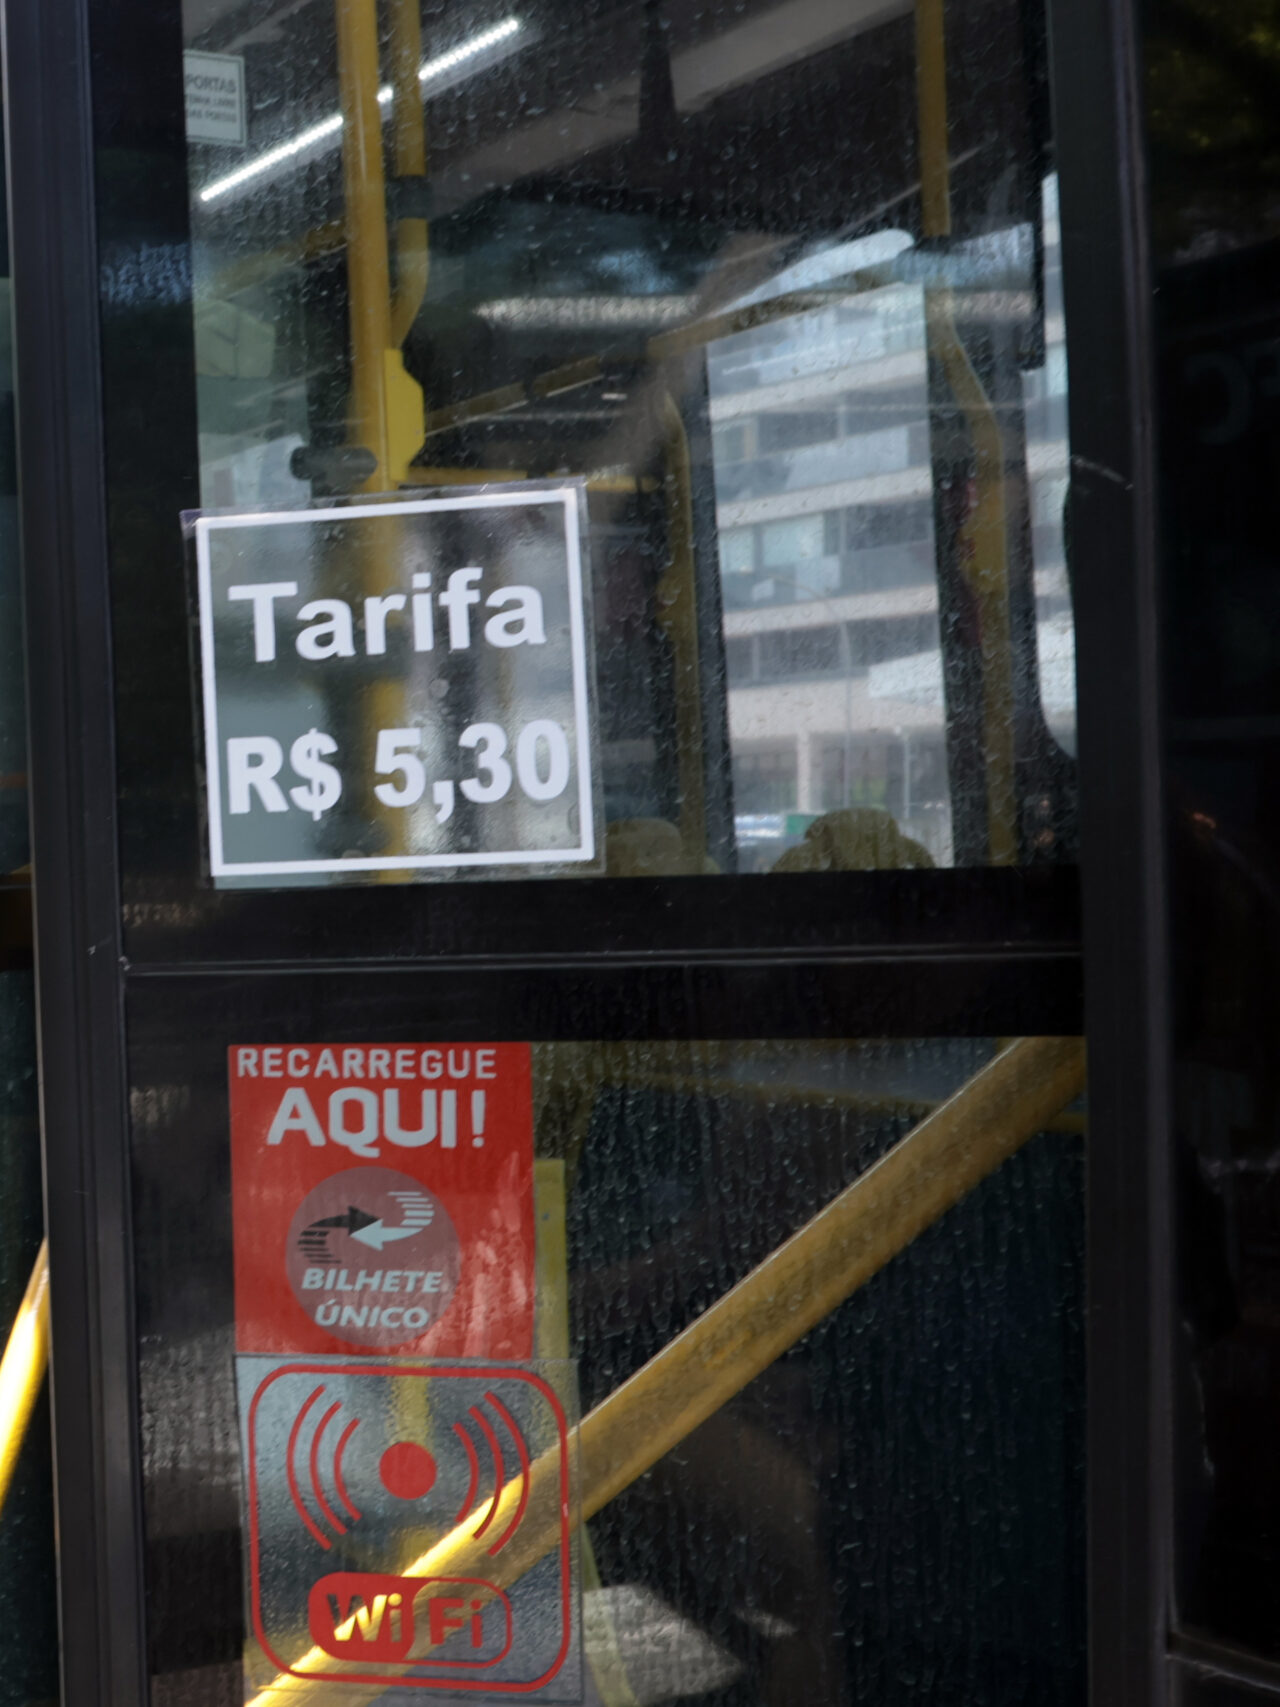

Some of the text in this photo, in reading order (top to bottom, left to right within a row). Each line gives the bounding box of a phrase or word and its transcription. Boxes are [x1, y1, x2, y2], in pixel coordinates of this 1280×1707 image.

[228, 567, 547, 663] Tarifa
[227, 719, 570, 823] R$ 5,30
[237, 1048, 497, 1079] RECARREGUE
[301, 1268, 442, 1293] BILHETE
[314, 1299, 429, 1329] ÚNICO
